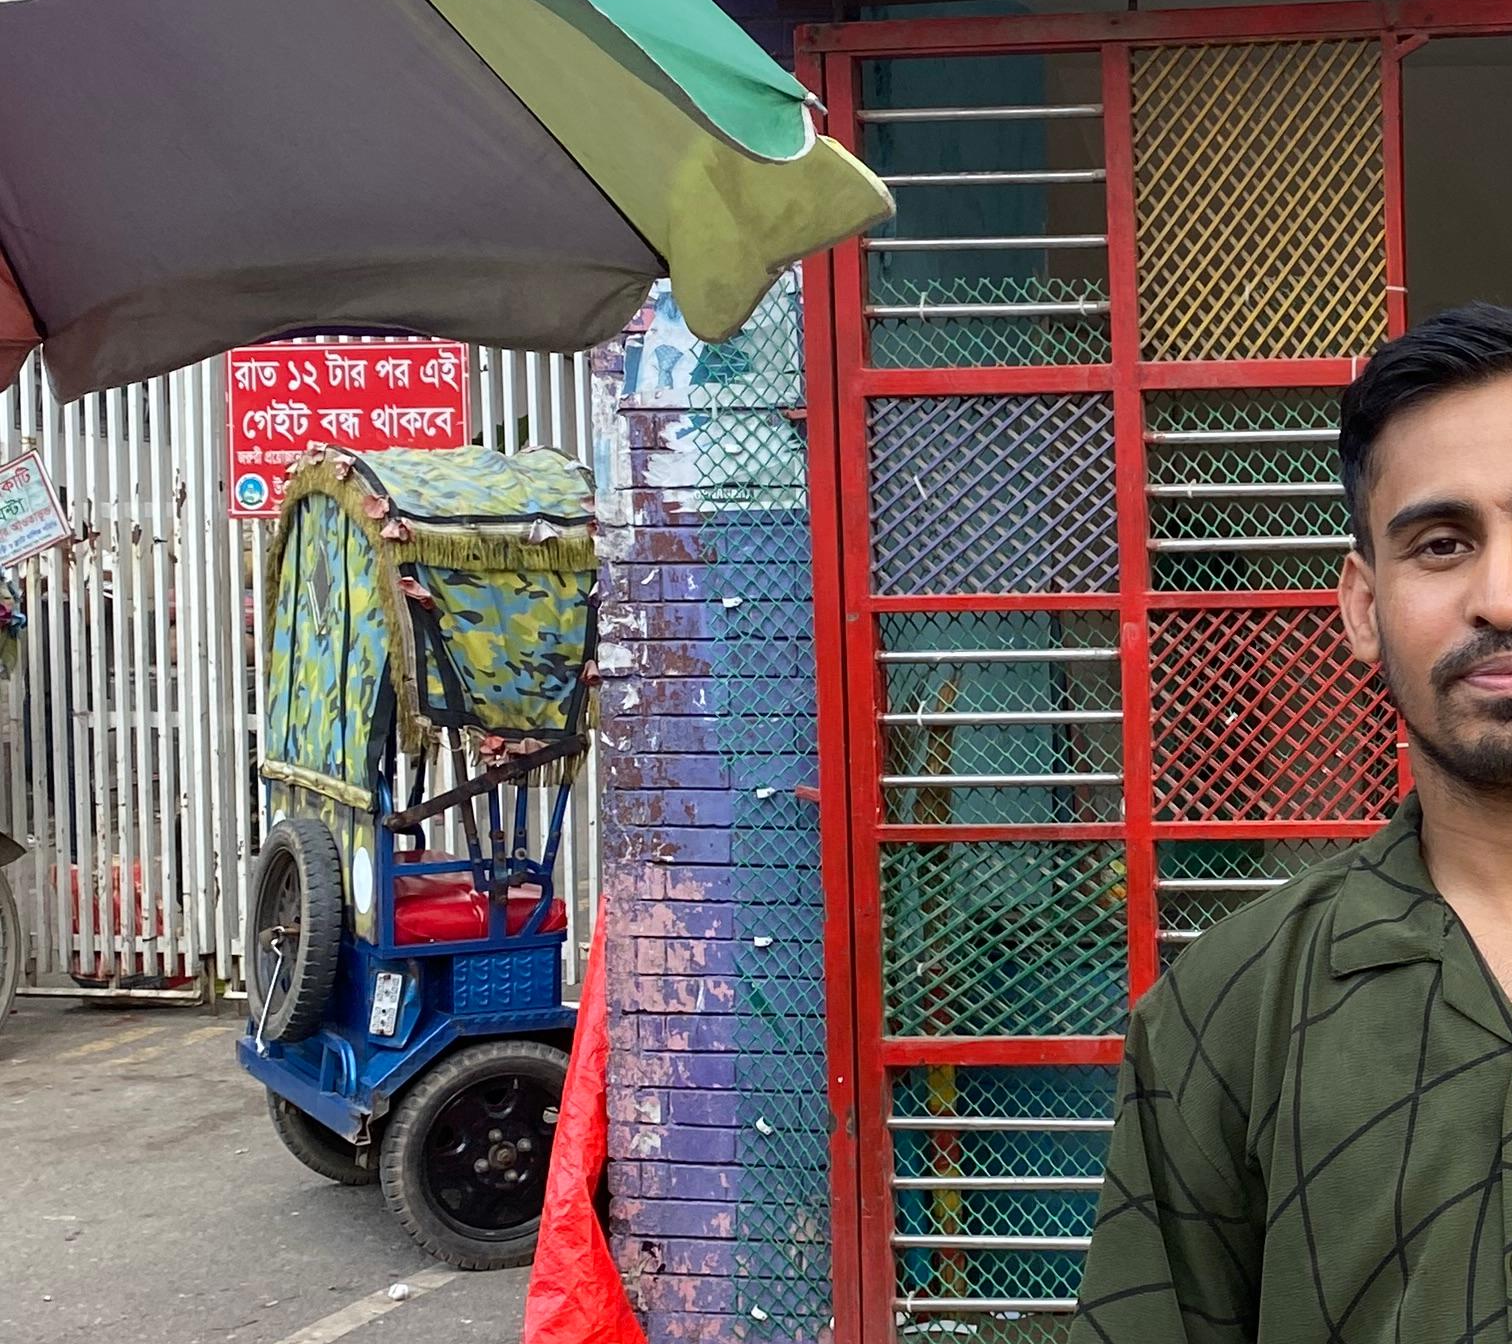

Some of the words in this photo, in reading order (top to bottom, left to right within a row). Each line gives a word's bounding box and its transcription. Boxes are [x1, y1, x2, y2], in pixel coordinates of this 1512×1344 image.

[233, 359, 279, 391] রাত
[287, 359, 321, 393] ১২
[325, 349, 368, 389] টার
[375, 357, 412, 389] পর
[419, 347, 460, 391] এই
[242, 399, 312, 441] গেইট
[316, 408, 364, 439] বন্ধ
[371, 405, 455, 438] থাকবে
